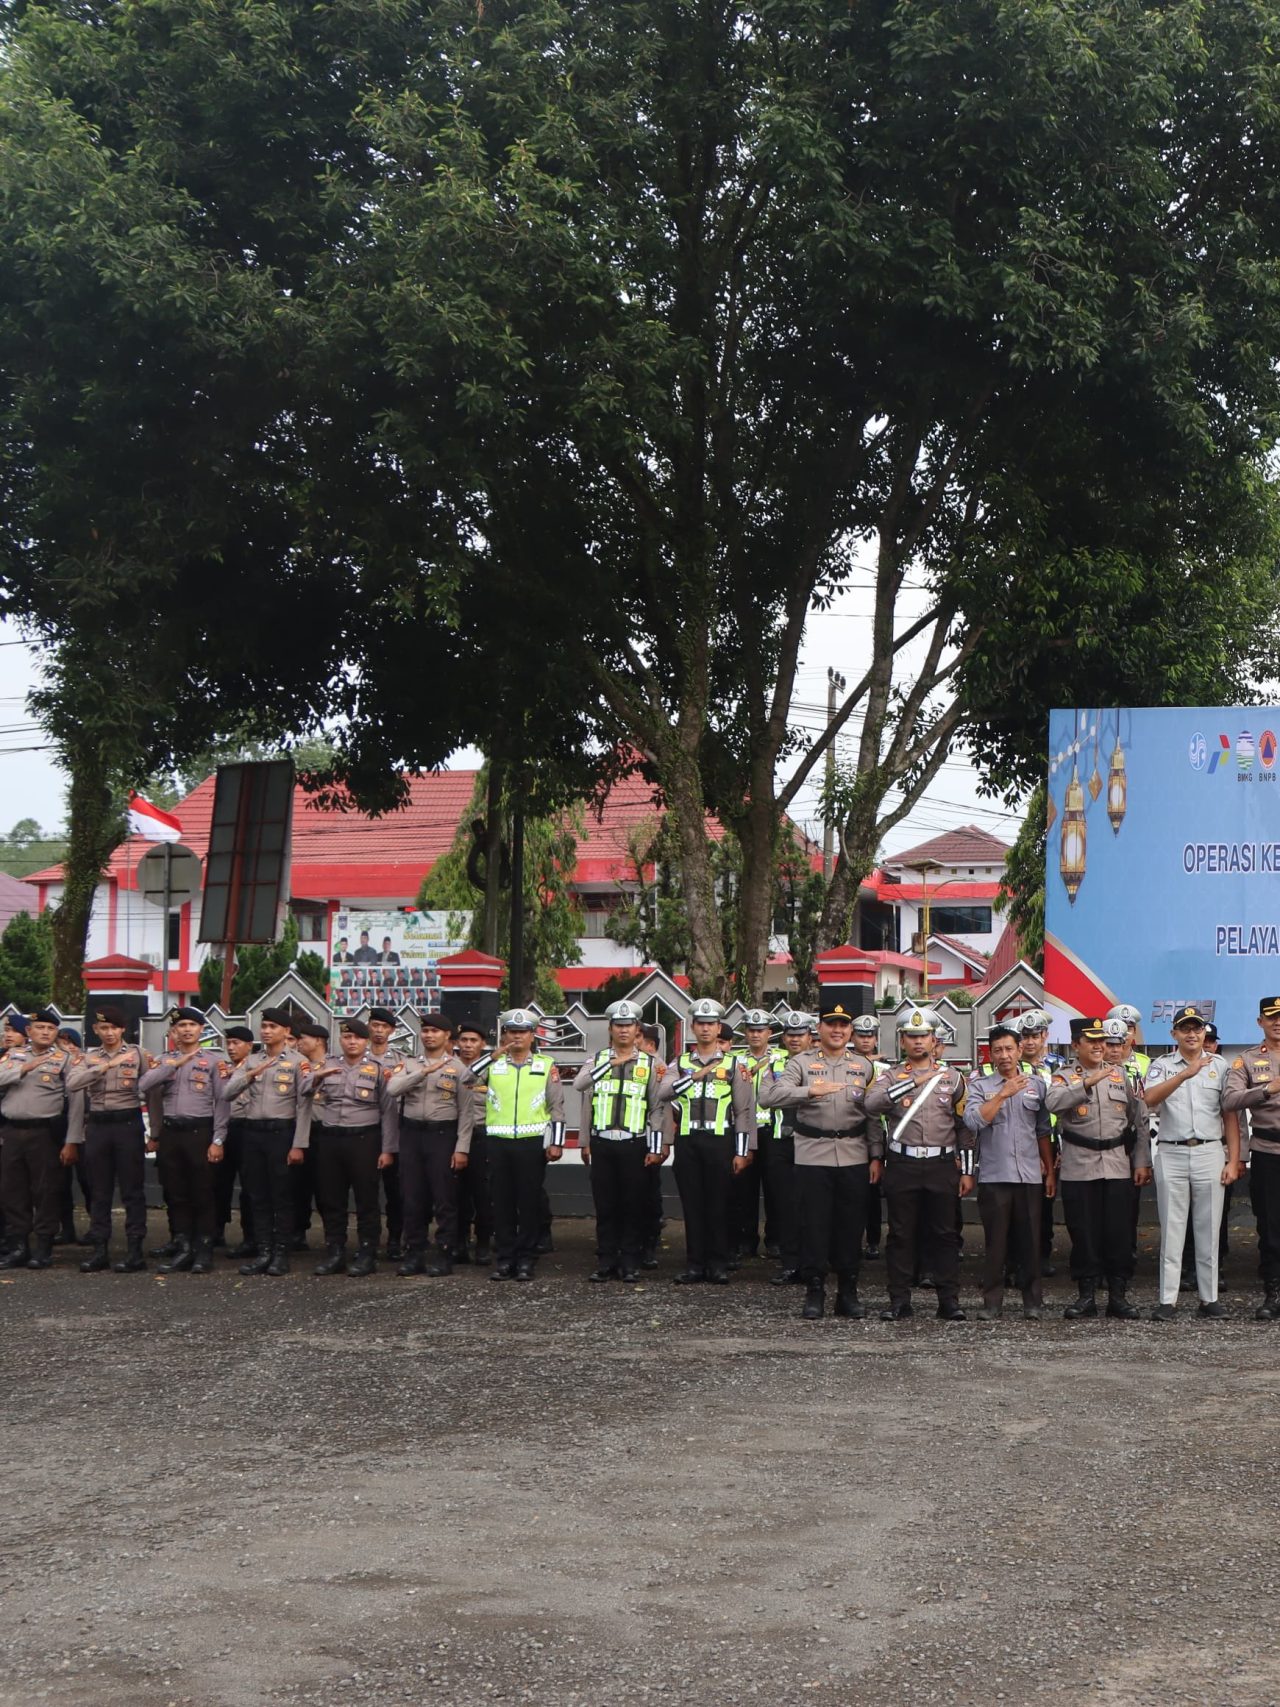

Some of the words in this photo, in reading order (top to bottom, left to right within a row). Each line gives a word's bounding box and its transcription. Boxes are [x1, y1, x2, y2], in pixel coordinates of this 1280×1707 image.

[1237, 773, 1253, 782] BMKG
[1258, 772, 1276, 782] BNPB
[1183, 842, 1256, 873] OPERASI
[594, 1080, 646, 1095] POLISI
